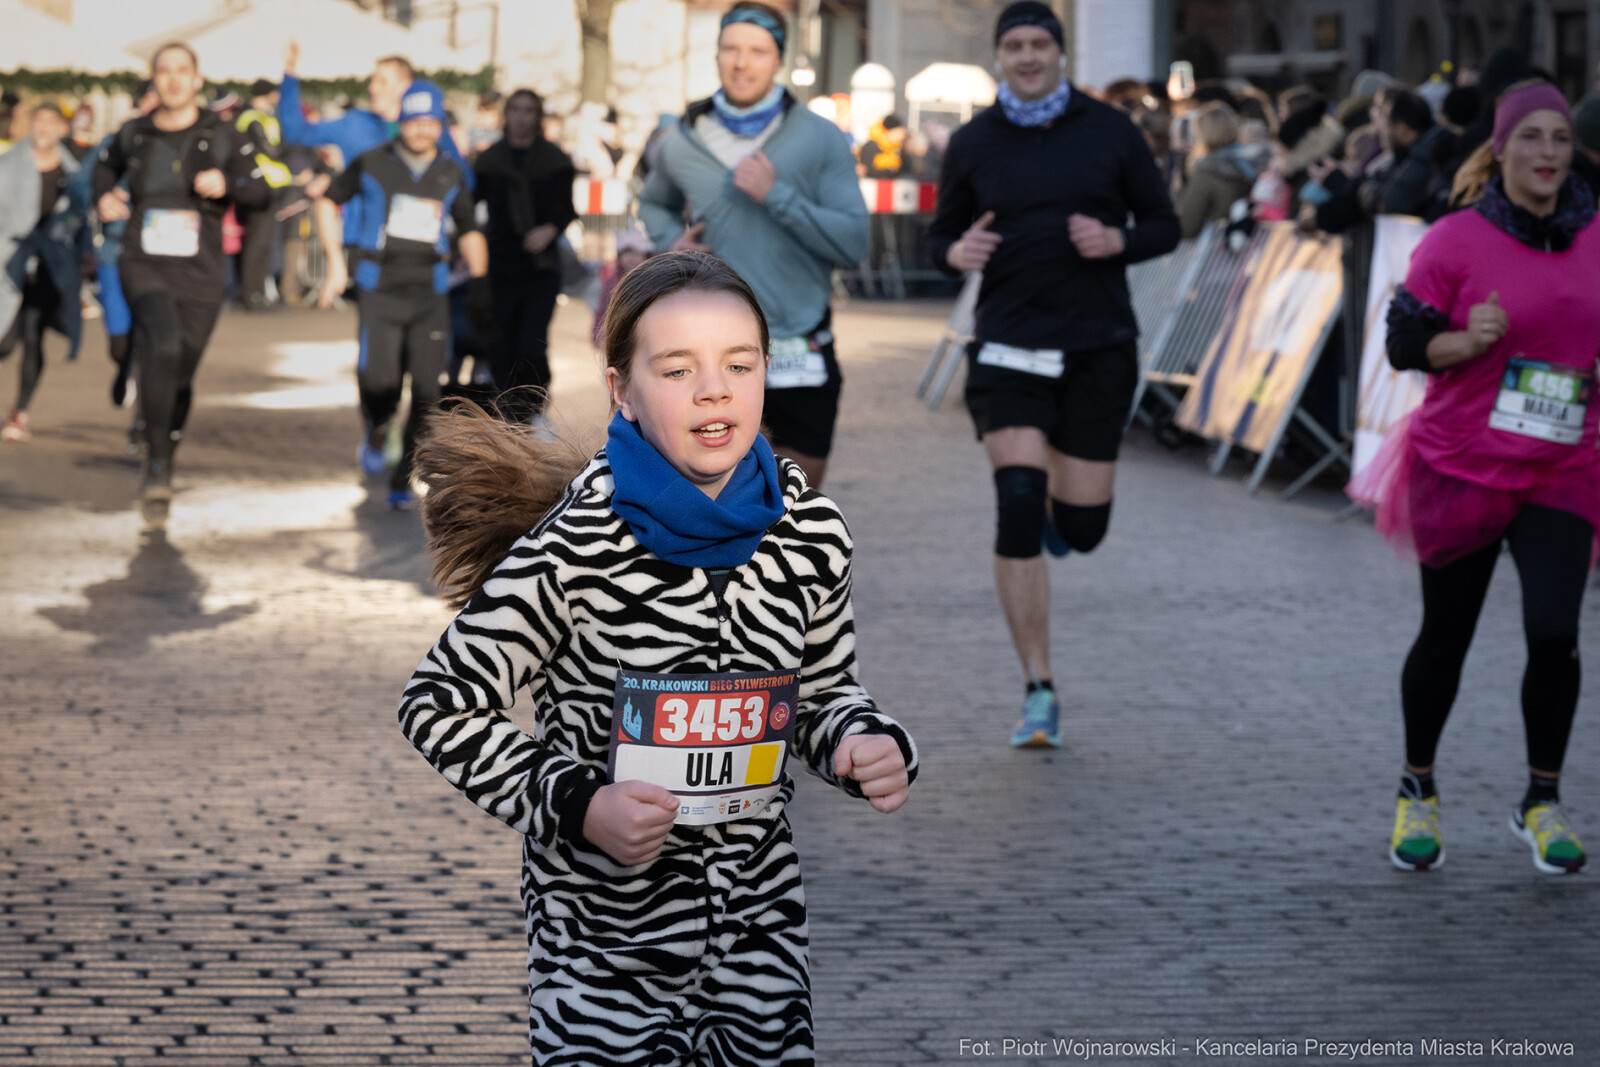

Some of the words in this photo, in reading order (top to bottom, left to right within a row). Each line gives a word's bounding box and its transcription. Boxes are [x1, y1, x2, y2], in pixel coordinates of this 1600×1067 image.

[1529, 371, 1575, 402] 456
[623, 677, 641, 690] 20.
[641, 679, 709, 692] KRAKOWSKI
[709, 680, 733, 692] BIEG
[734, 673, 795, 691] SYLWESTROWY
[659, 695, 765, 742] 3453
[685, 751, 733, 787] ULA
